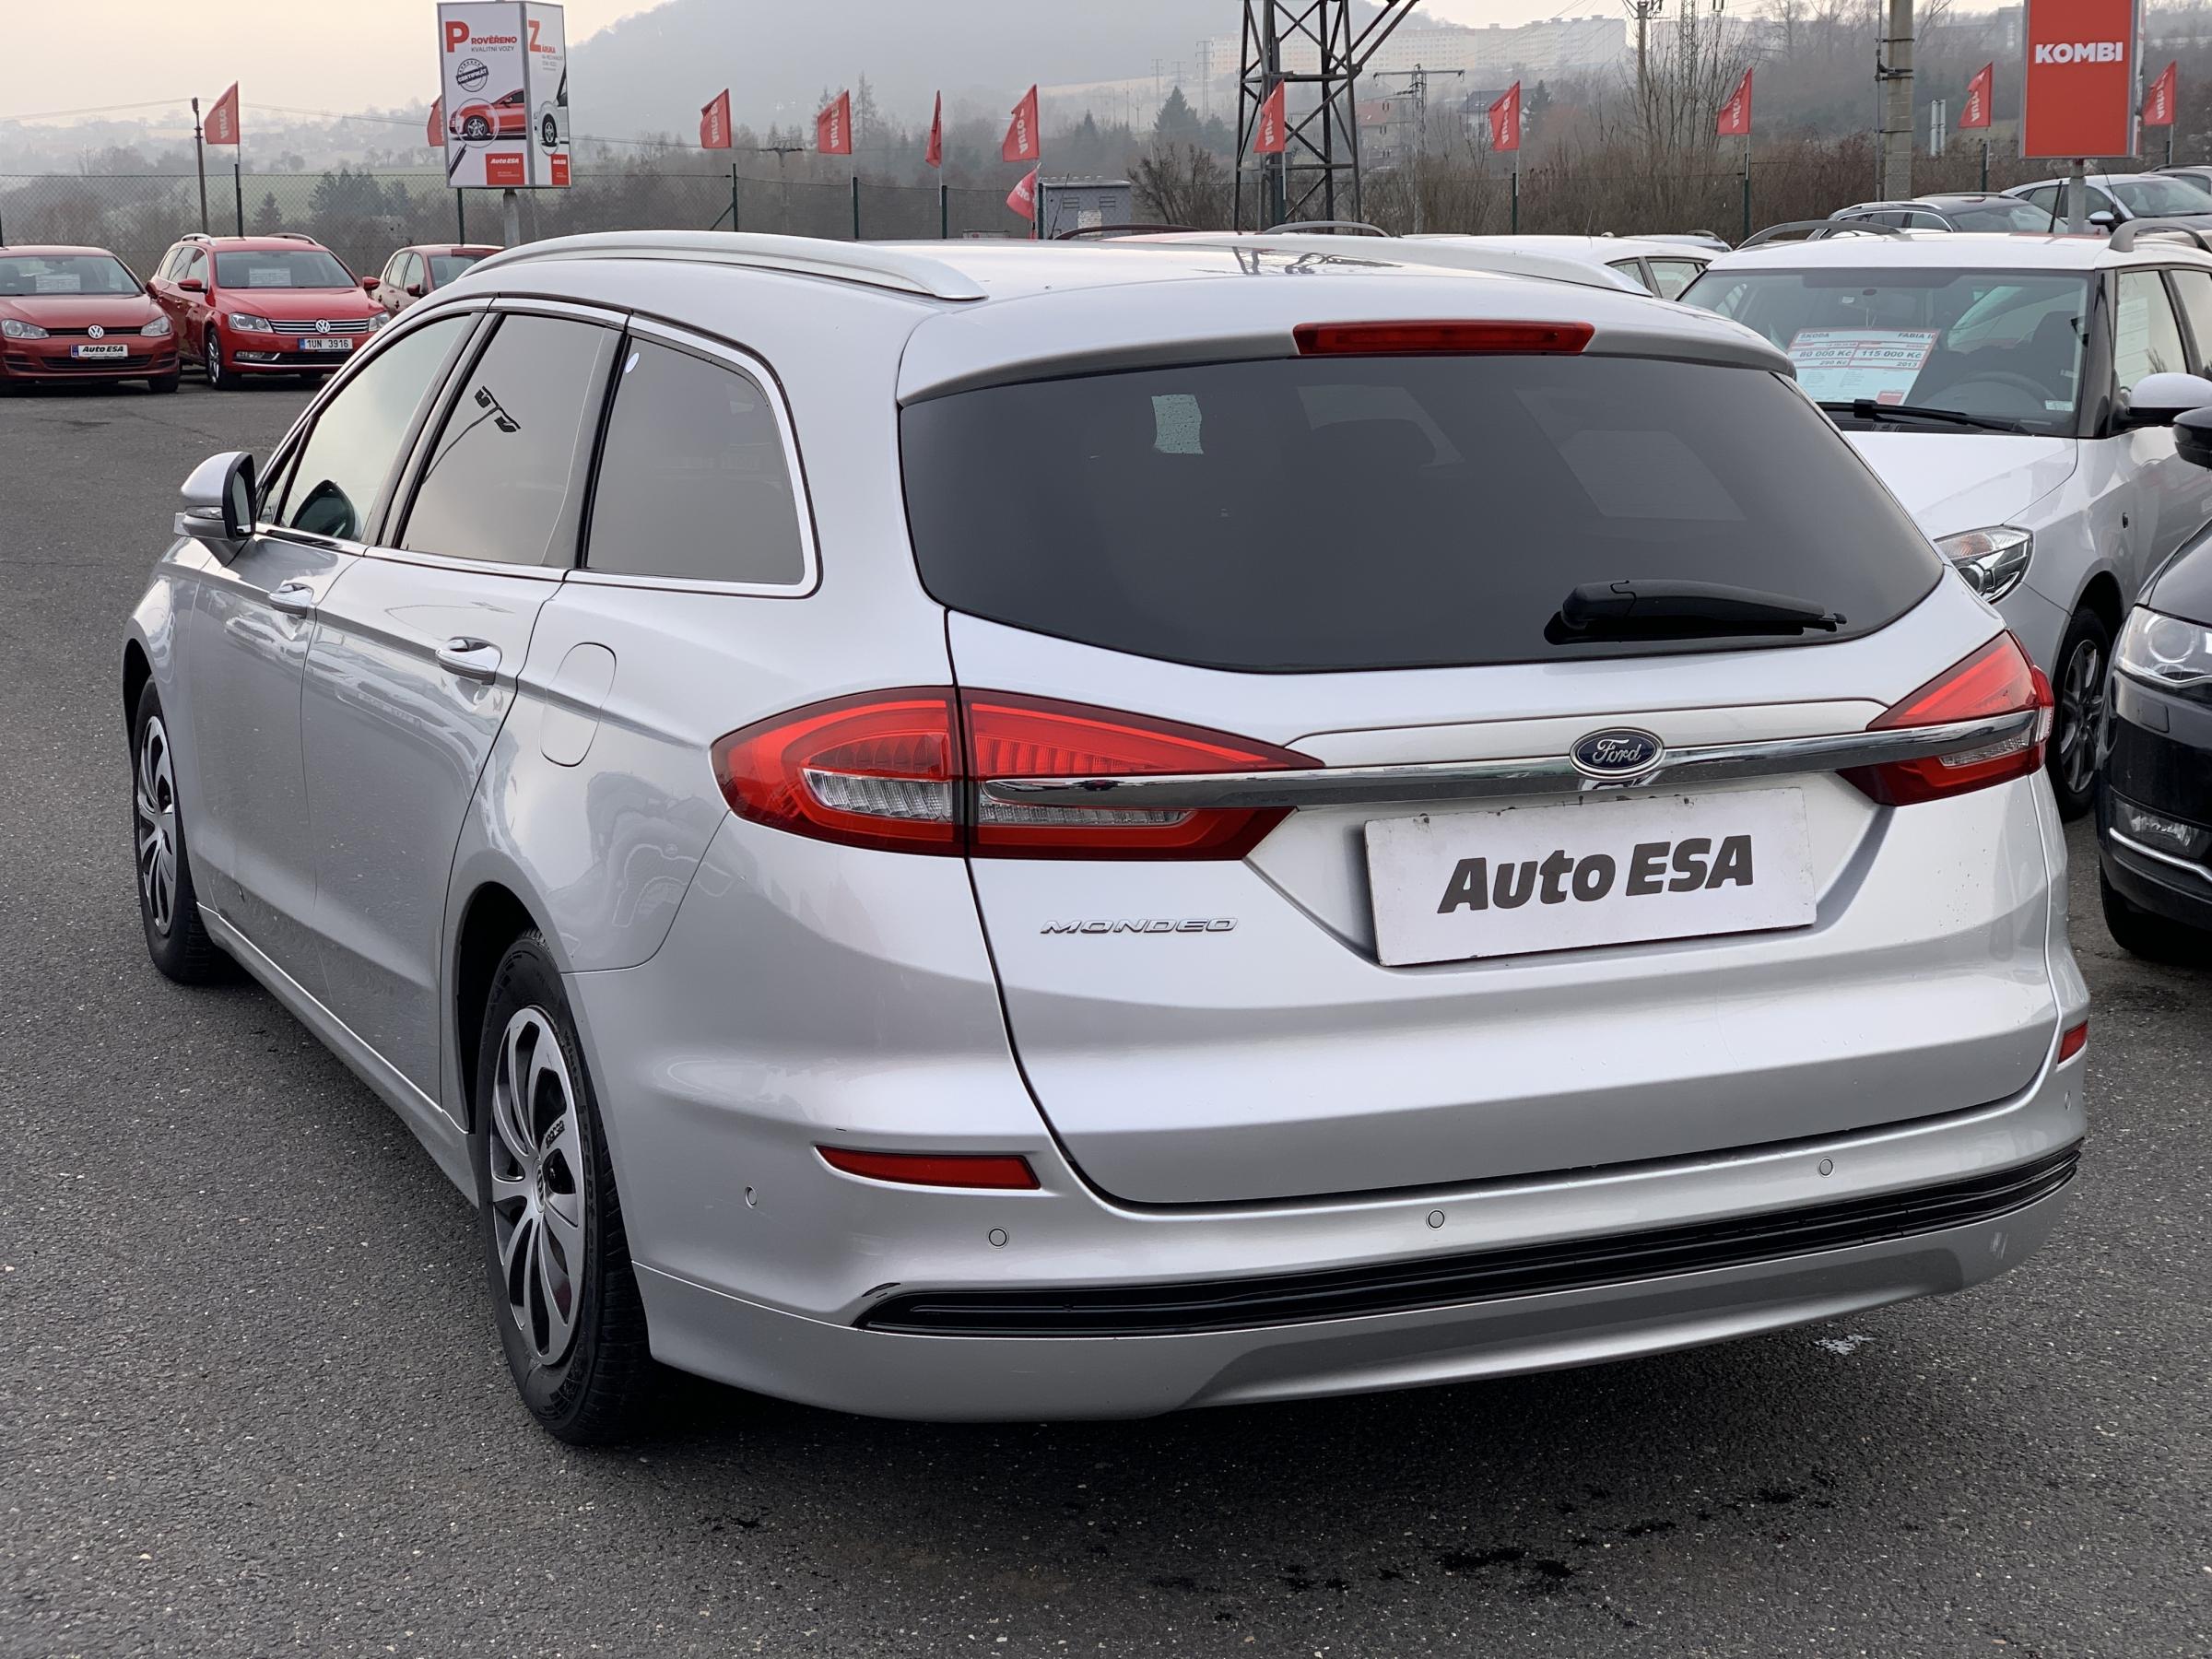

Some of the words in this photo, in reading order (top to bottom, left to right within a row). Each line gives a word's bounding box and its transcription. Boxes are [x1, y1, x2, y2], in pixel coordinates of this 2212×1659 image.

[2035, 41, 2124, 64] KOMBI
[307, 339, 323, 348] 1UN
[328, 339, 349, 348] 3916
[1592, 738, 1642, 764] Ford
[1436, 849, 1617, 914] Auto
[1625, 834, 1754, 897] ESA
[1040, 917, 1239, 935] MONDEO
